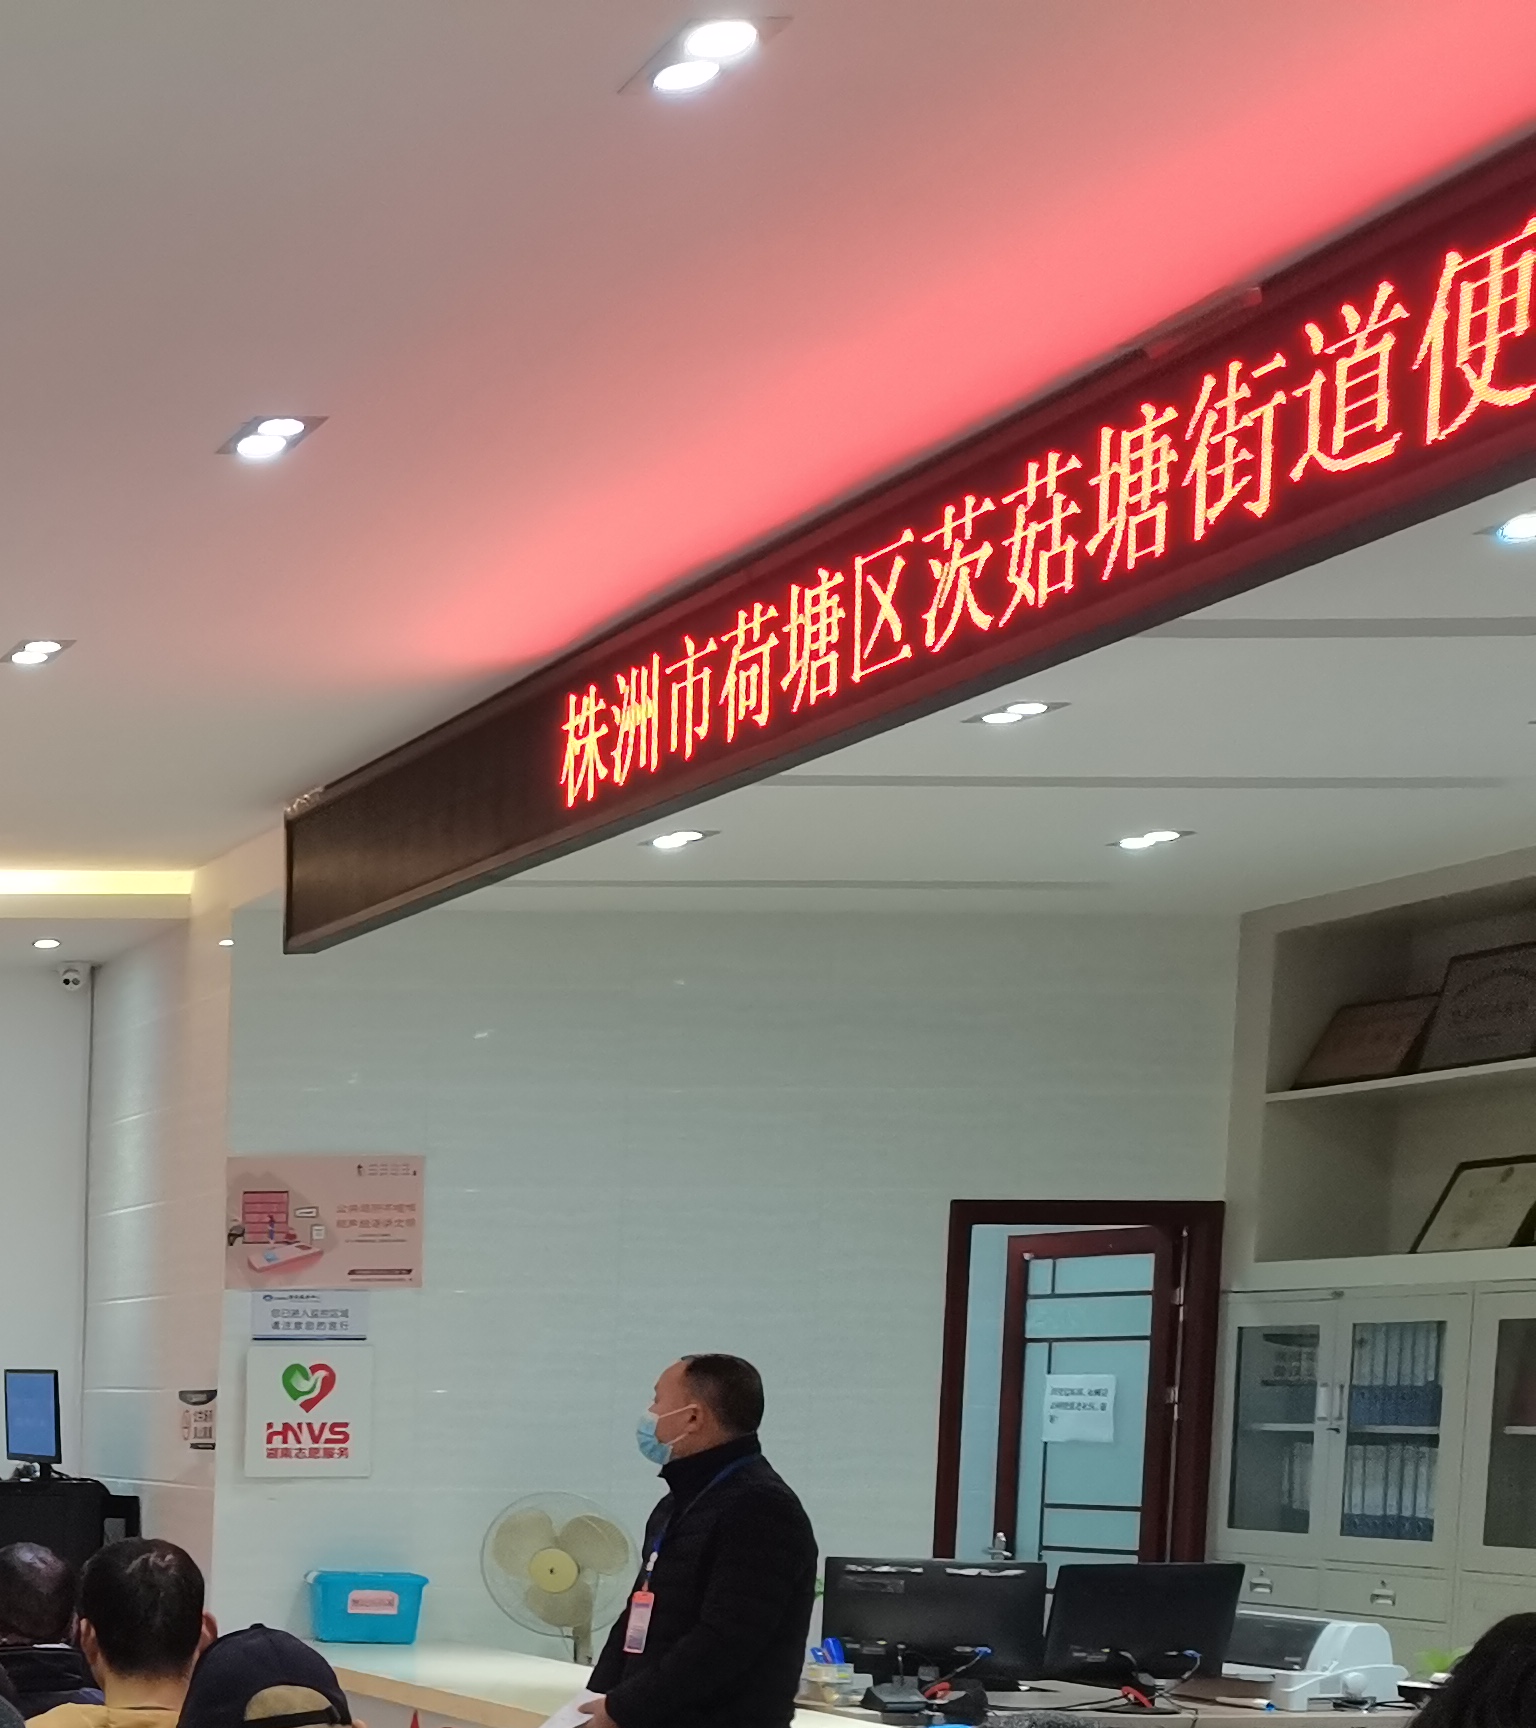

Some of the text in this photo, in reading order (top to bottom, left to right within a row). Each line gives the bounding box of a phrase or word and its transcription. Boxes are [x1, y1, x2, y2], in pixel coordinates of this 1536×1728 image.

[558, 218, 1536, 809] 株洲市荷塘区茨菇塘街道便
[265, 1421, 351, 1445] HNVS
